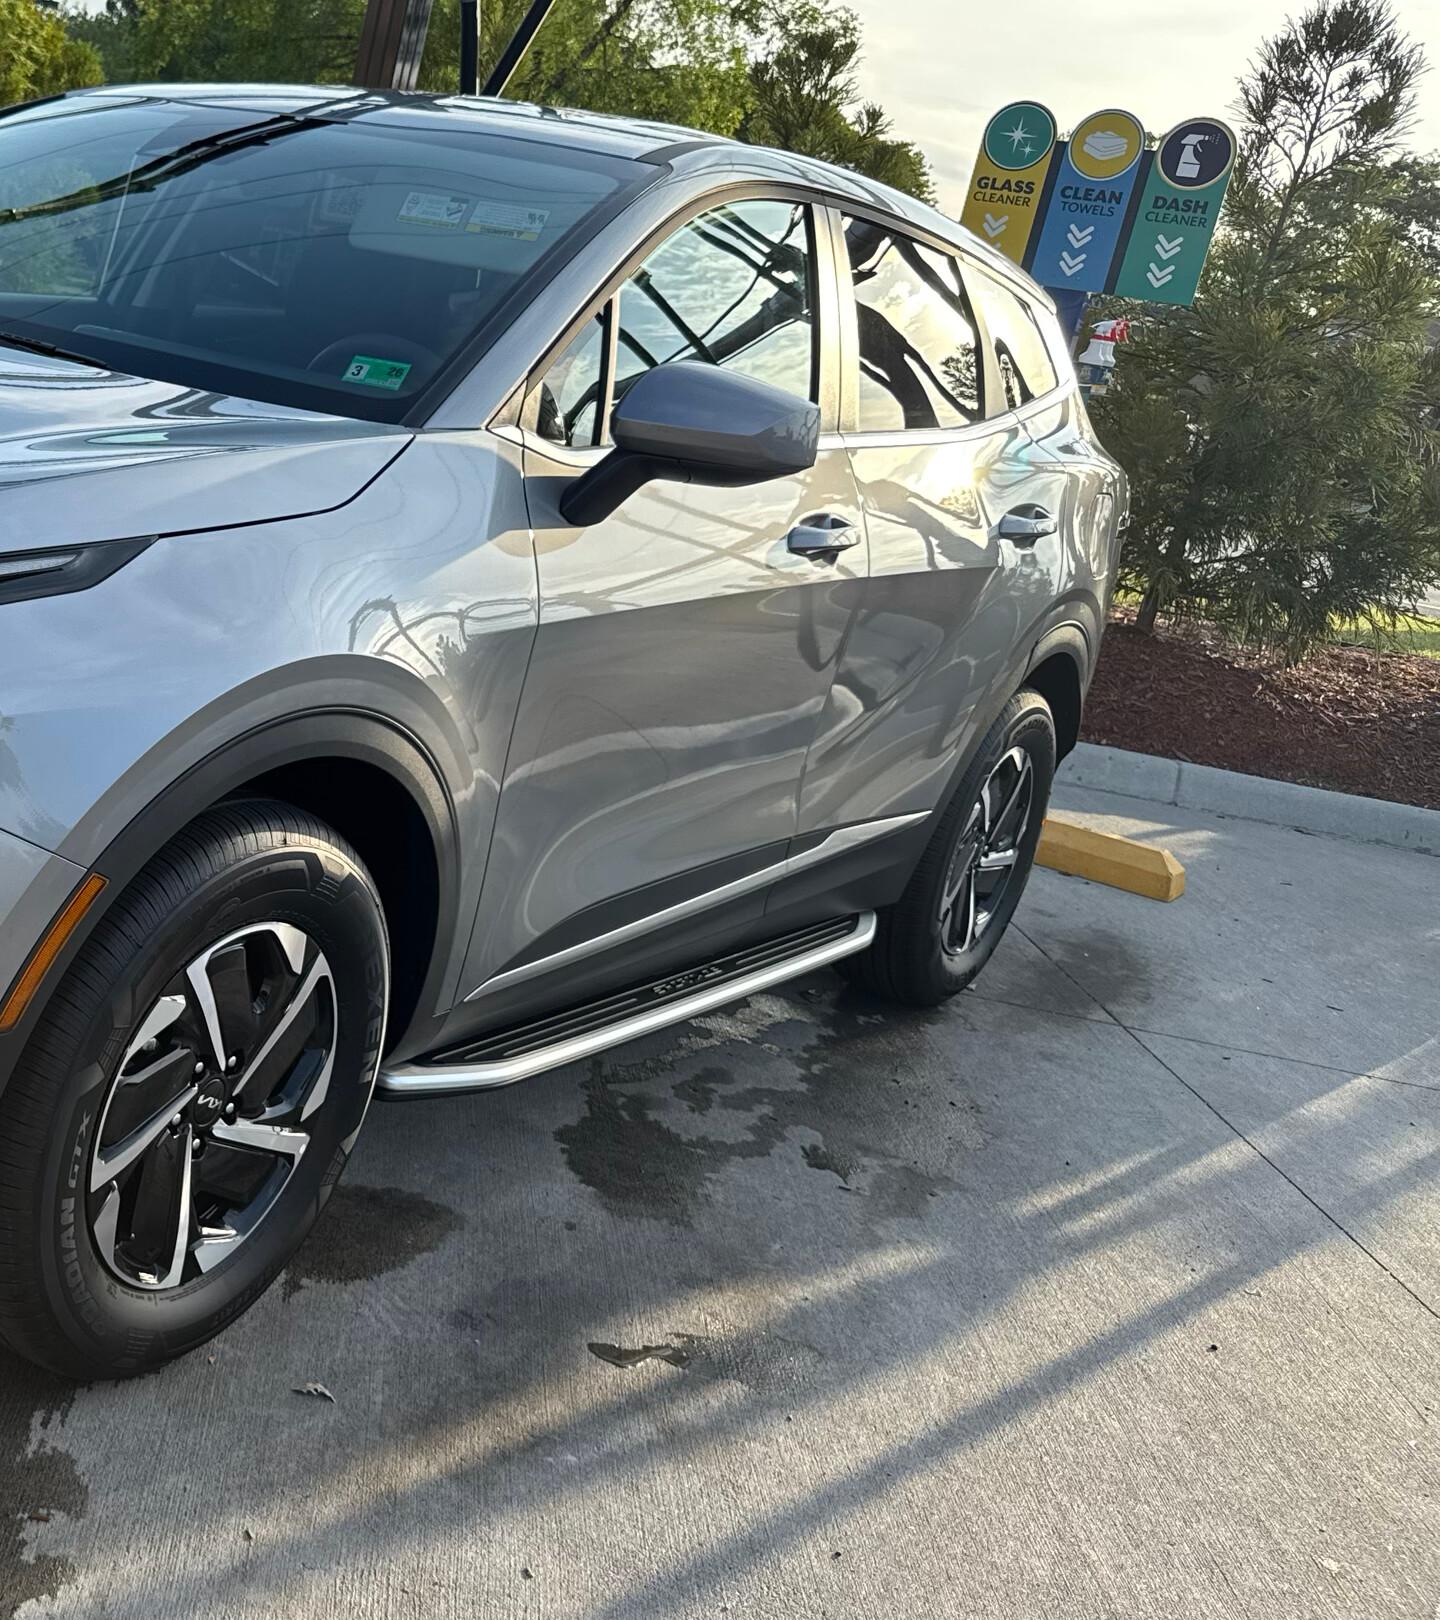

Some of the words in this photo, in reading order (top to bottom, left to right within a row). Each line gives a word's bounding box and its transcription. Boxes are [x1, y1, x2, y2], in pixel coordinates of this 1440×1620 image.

[976, 176, 1036, 194] GLASS
[973, 191, 1031, 207] CLEANER
[1060, 185, 1124, 205] CLEAN
[1060, 201, 1115, 217] TOWELS
[1152, 195, 1209, 215] DASH
[1145, 211, 1208, 229] CLEANER
[351, 365, 364, 377] 3
[387, 366, 405, 378] 26
[359, 945, 383, 1084] EXEN
[68, 1111, 92, 1189] GTX
